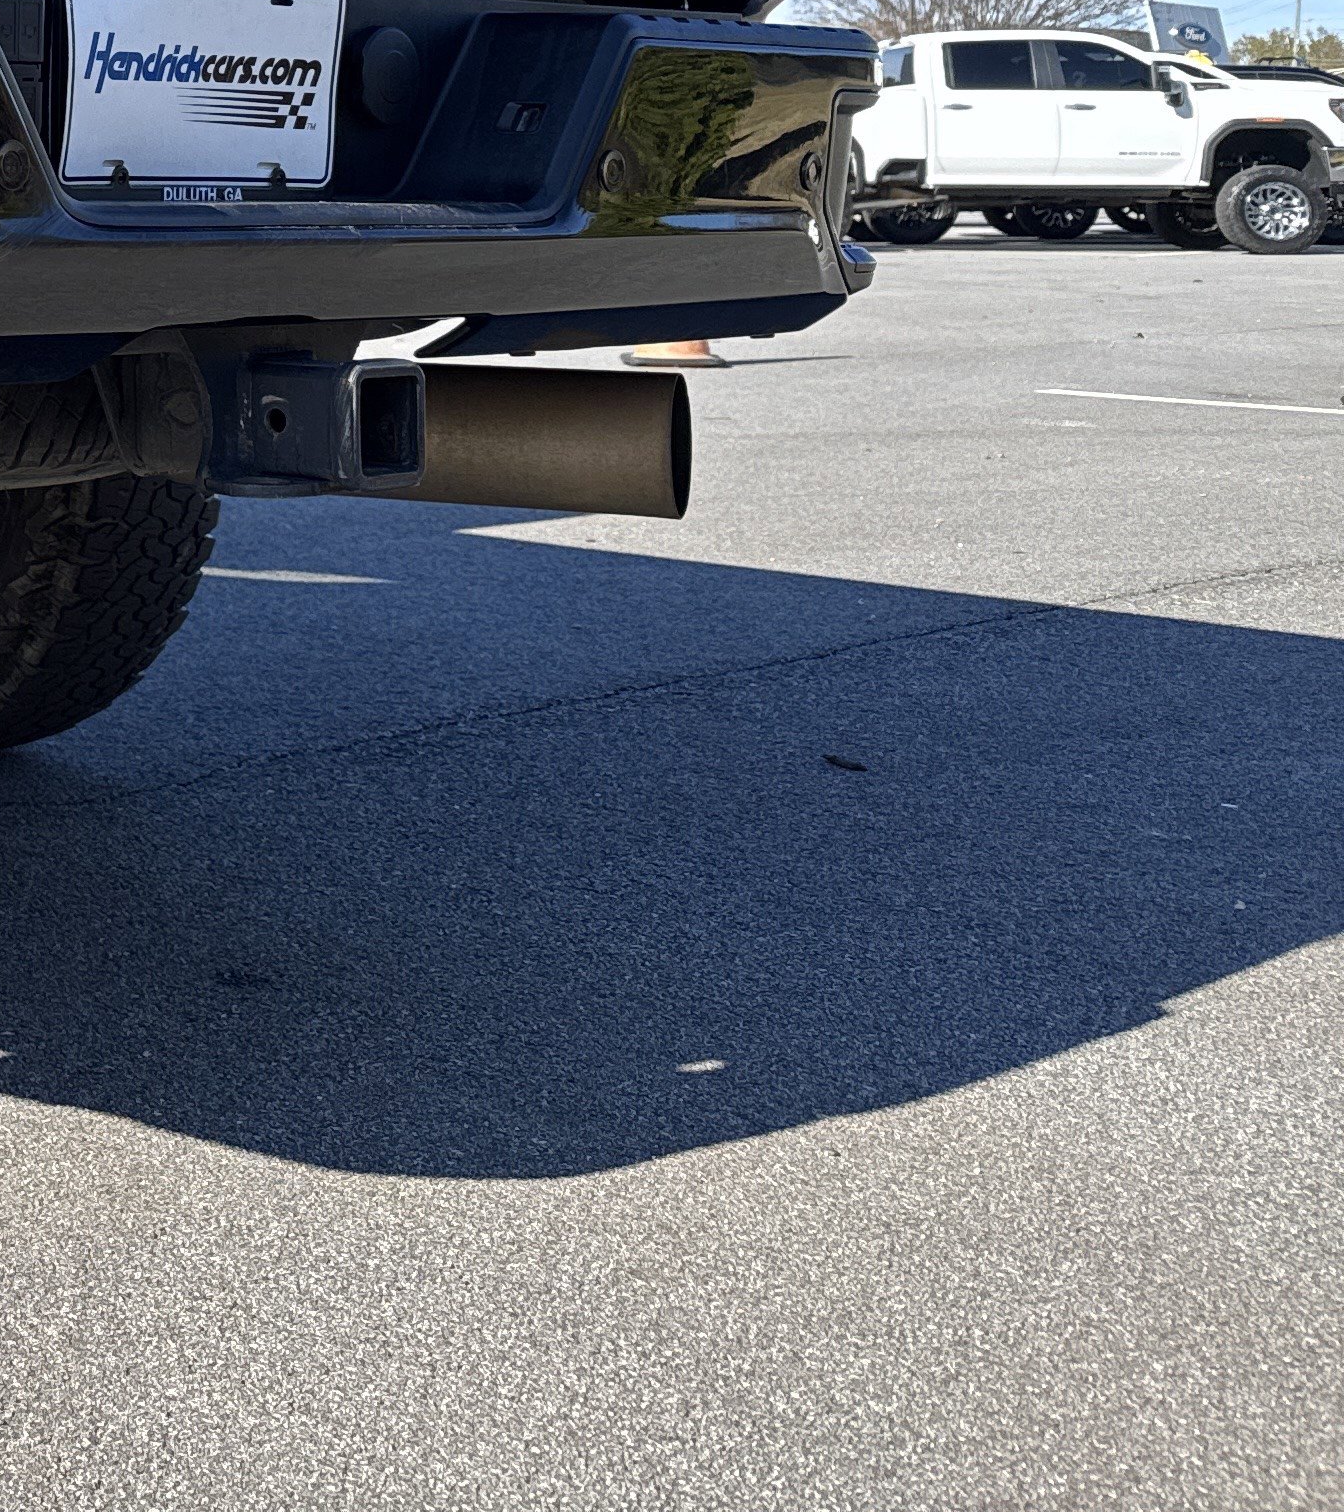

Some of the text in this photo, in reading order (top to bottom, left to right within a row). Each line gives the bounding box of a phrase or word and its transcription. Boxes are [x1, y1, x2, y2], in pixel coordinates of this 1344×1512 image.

[1185, 26, 1206, 41] Ford
[84, 31, 323, 94] Hendrickcars.com
[163, 186, 243, 202] DULUTH GA
